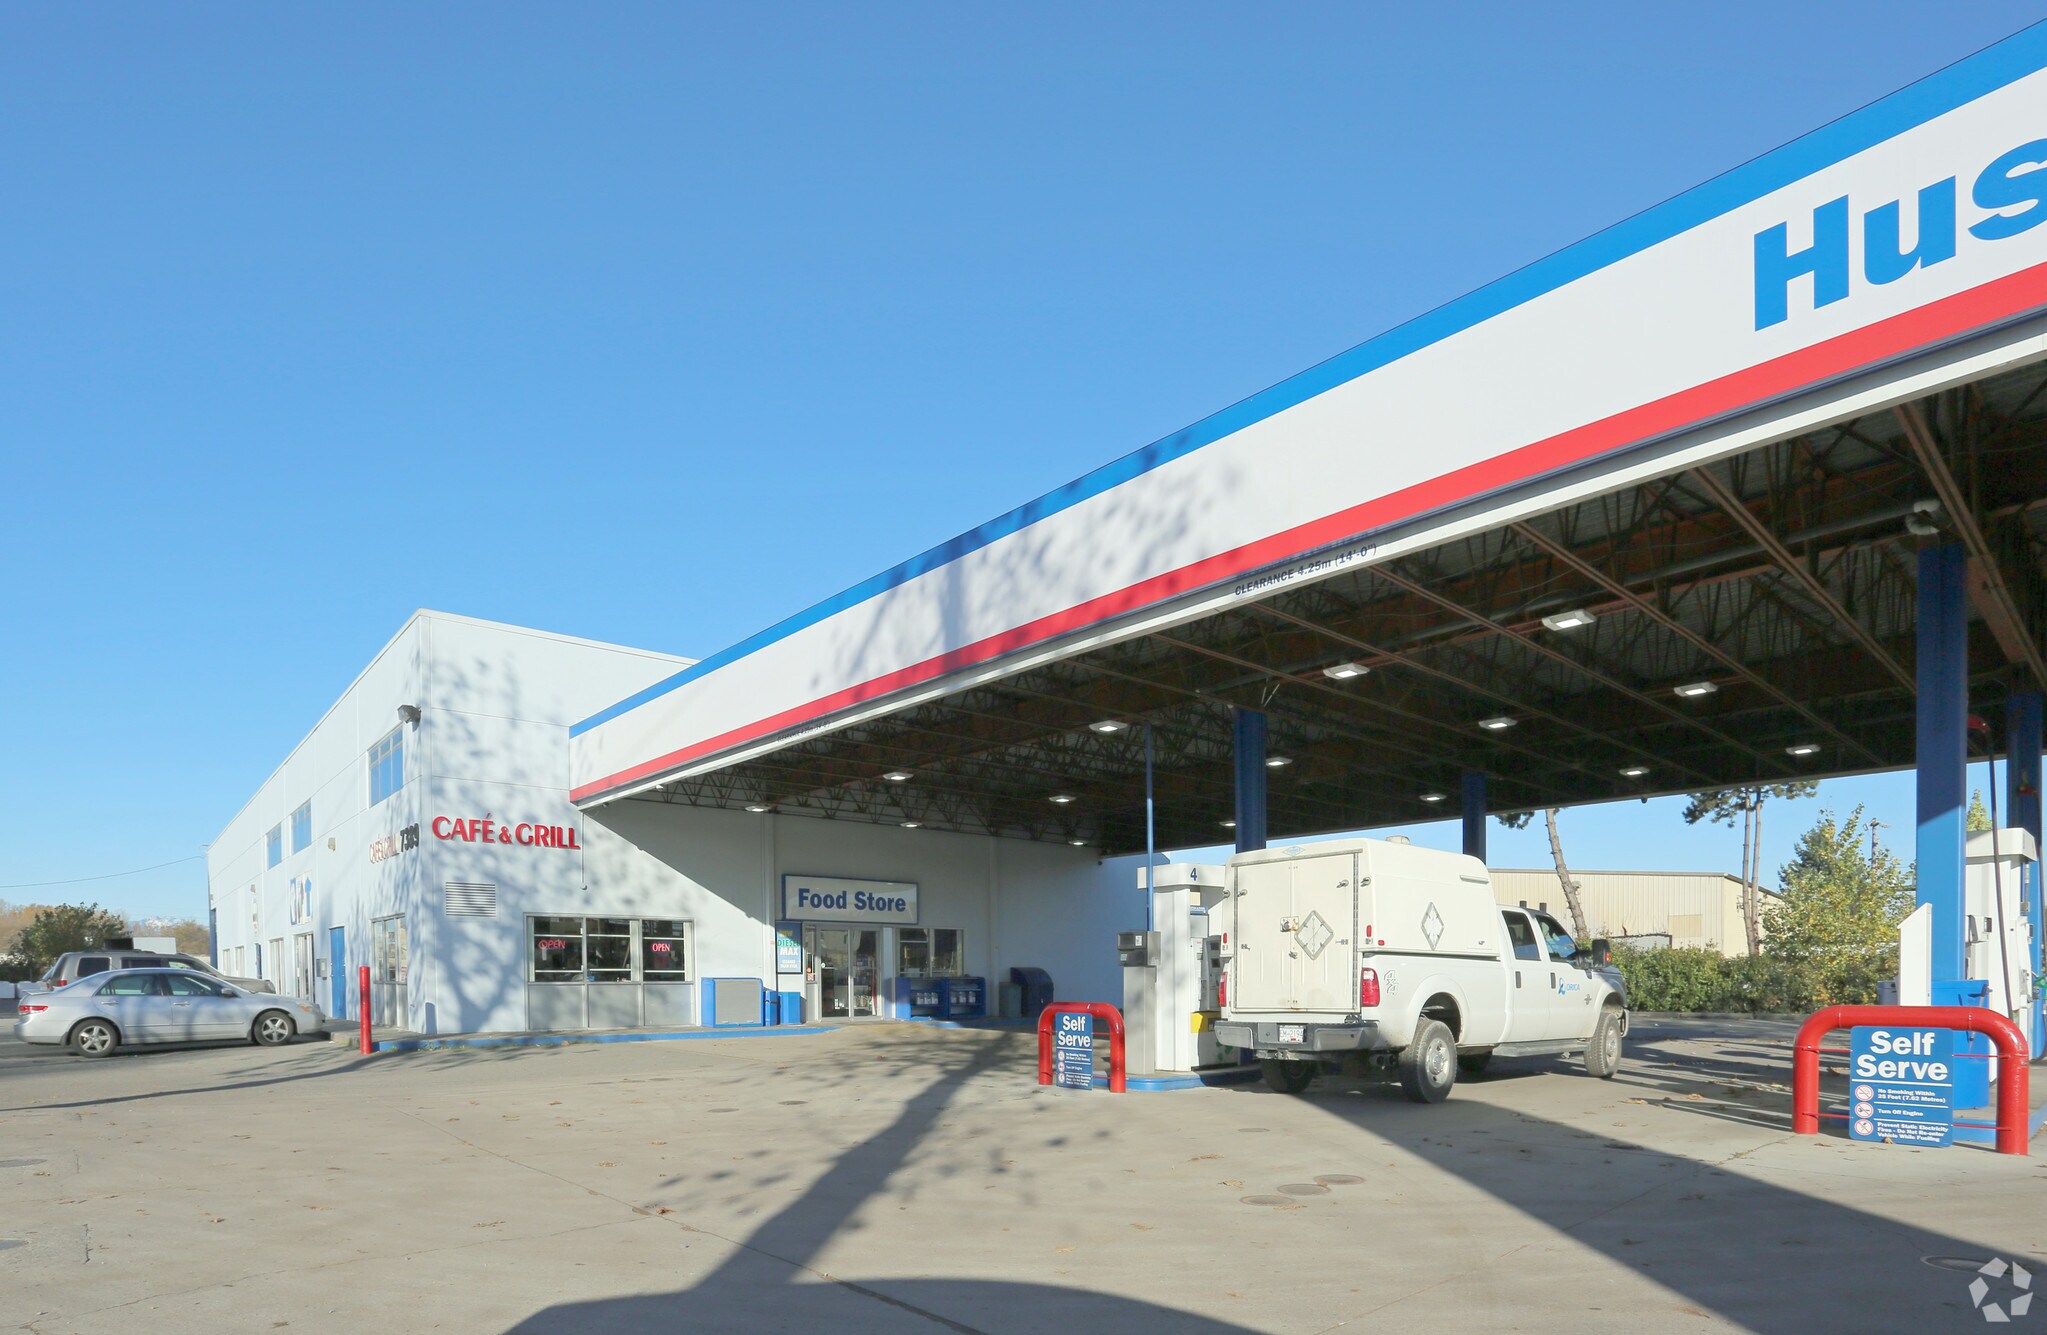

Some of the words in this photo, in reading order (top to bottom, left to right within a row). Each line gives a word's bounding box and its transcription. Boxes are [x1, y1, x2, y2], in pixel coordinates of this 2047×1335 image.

[1754, 138, 2047, 332] Hus
[1235, 569, 1294, 596] CLEARANCE
[1298, 560, 1331, 576] 4.25m
[400, 823, 419, 852] 7389
[432, 812, 496, 843] CAFÉ
[499, 826, 512, 844] &
[515, 823, 581, 850] GRILL
[1190, 867, 1198, 881] 4
[798, 888, 847, 909] Food
[854, 891, 906, 912] Store
[538, 939, 566, 949] OPEN
[652, 943, 671, 952] OPEN
[777, 939, 800, 947] DIESEL
[780, 947, 798, 956] MAX
[1062, 1015, 1085, 1031] Self
[1058, 1031, 1090, 1047] Serve
[1870, 1030, 1935, 1056] Self
[1856, 1054, 1948, 1081] Serve
